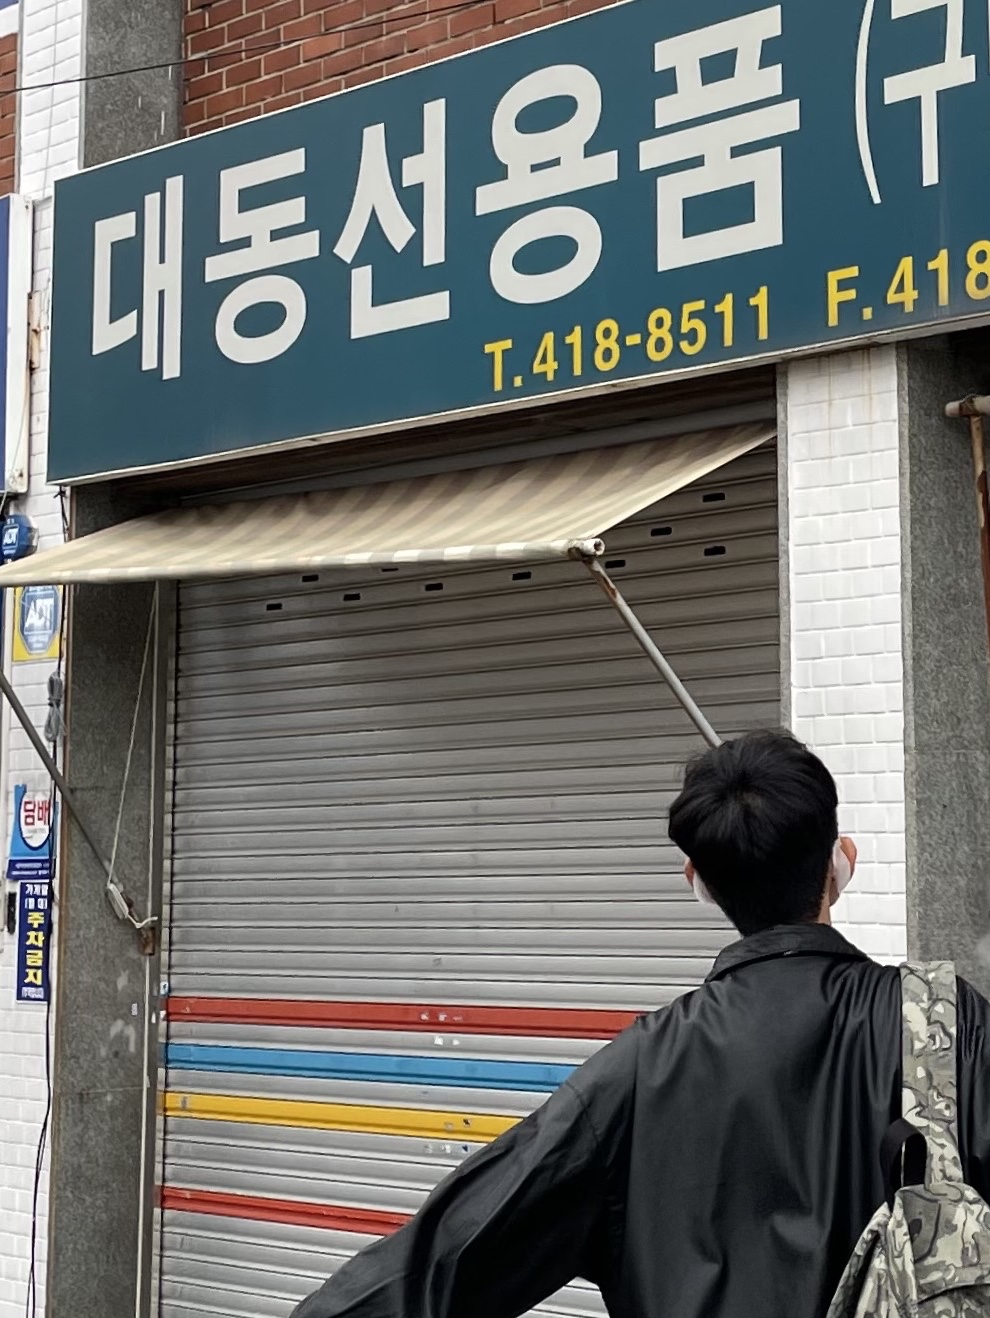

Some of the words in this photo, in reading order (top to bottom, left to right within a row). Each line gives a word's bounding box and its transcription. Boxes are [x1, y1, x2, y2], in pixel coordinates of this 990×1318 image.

[91, 4, 801, 381] 대동선용품
[485, 286, 769, 392] T.418-8511
[25, 598, 54, 629] ADT
[23, 800, 51, 827] 담배
[24, 911, 45, 986] 주차금지
